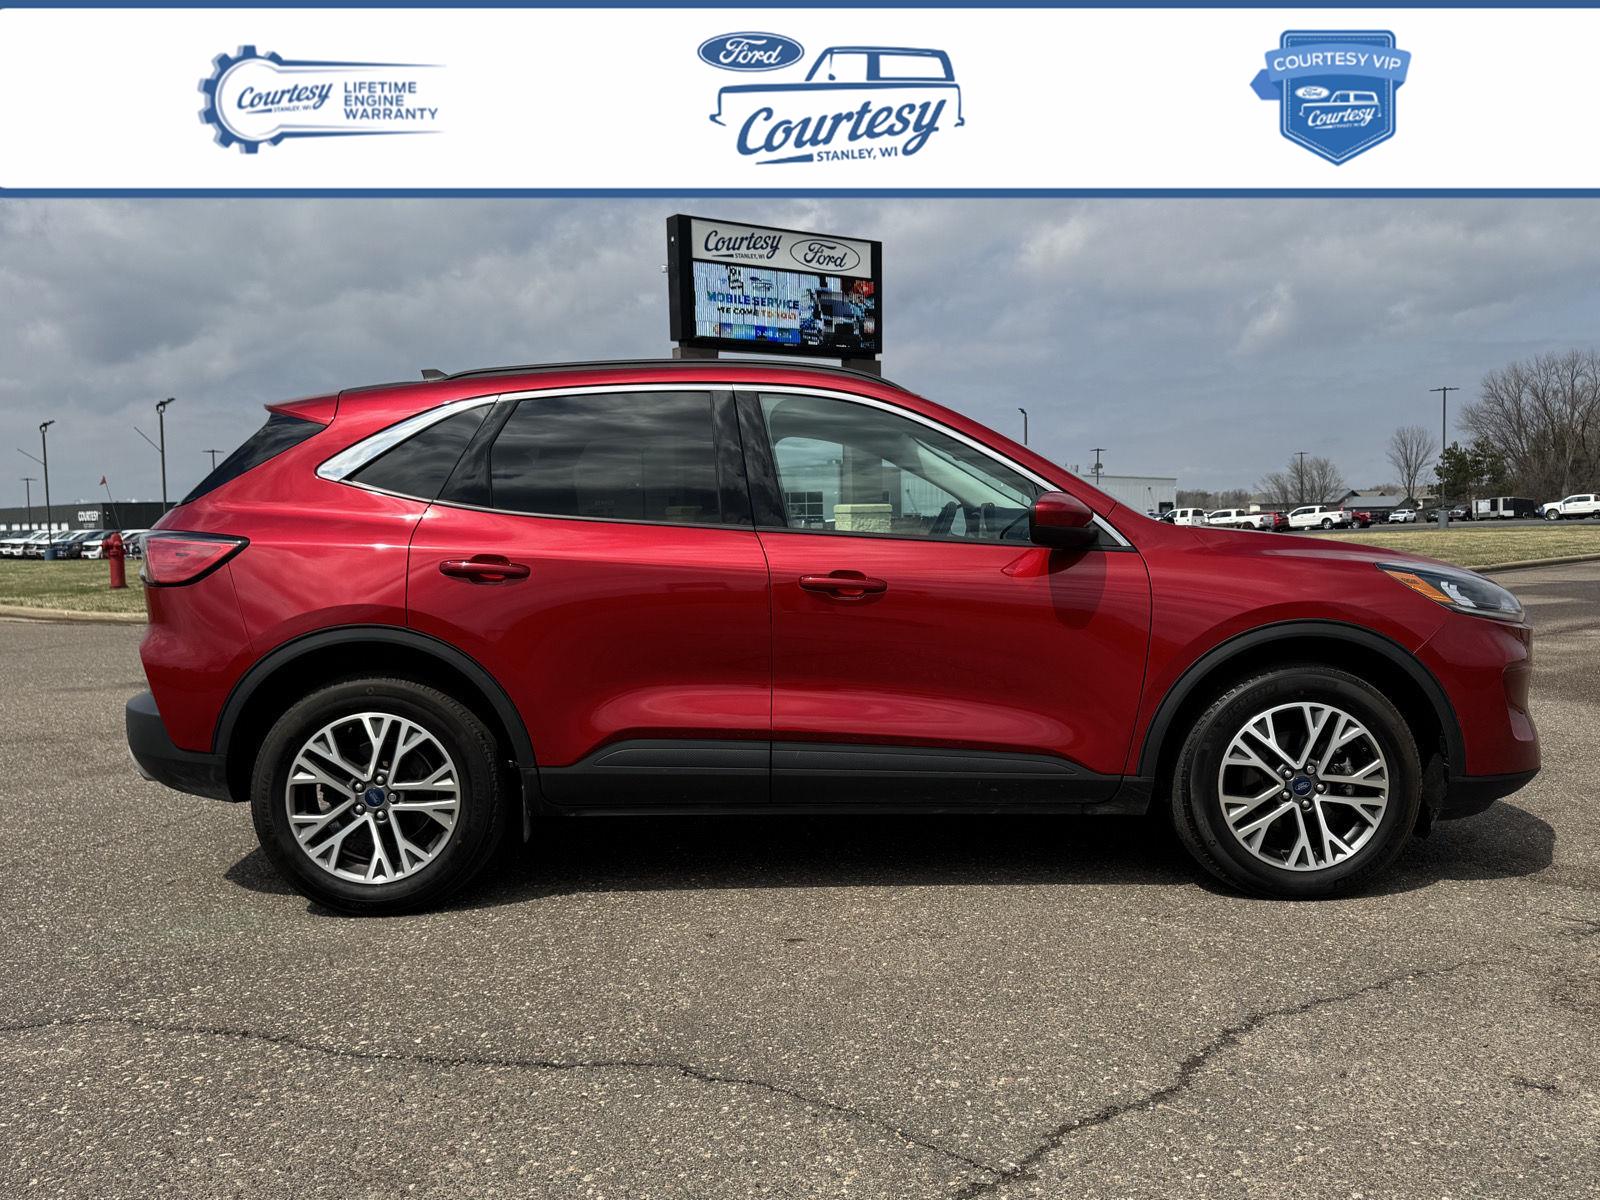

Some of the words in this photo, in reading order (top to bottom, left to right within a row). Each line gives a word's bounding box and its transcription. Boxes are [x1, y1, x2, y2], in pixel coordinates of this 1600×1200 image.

[704, 230, 783, 260] Courtesy
[803, 242, 847, 268] Ford
[707, 291, 751, 305] MOBILE
[752, 296, 800, 310] SERVICE
